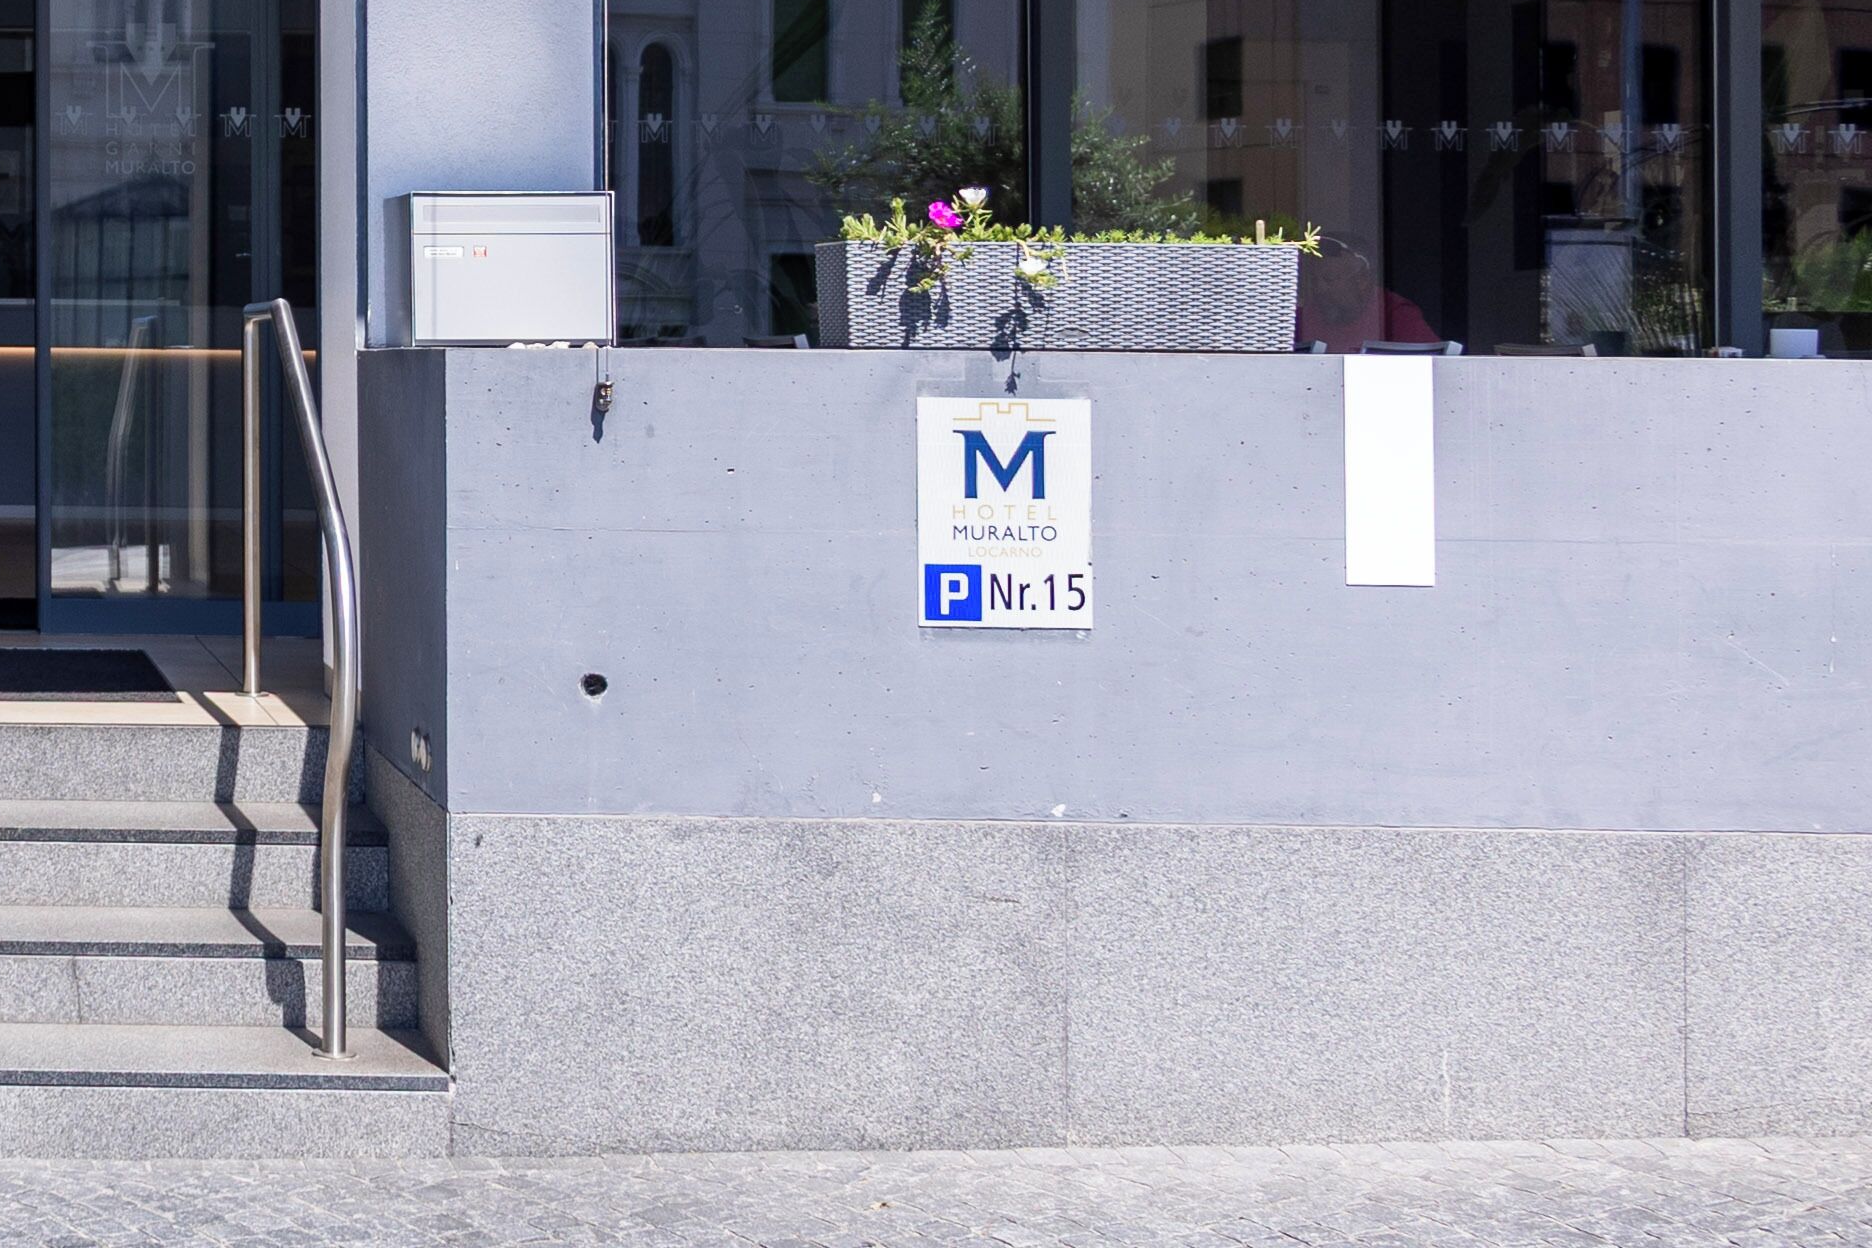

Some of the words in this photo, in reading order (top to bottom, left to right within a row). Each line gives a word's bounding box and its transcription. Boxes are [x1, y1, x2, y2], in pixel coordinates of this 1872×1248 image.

[105, 159, 196, 175] MURALTO
[952, 430, 1056, 500] M
[952, 504, 1057, 521] HOTEL
[952, 524, 1058, 542] MURALTO
[967, 545, 1043, 559] LOCARNO
[940, 572, 970, 616] P
